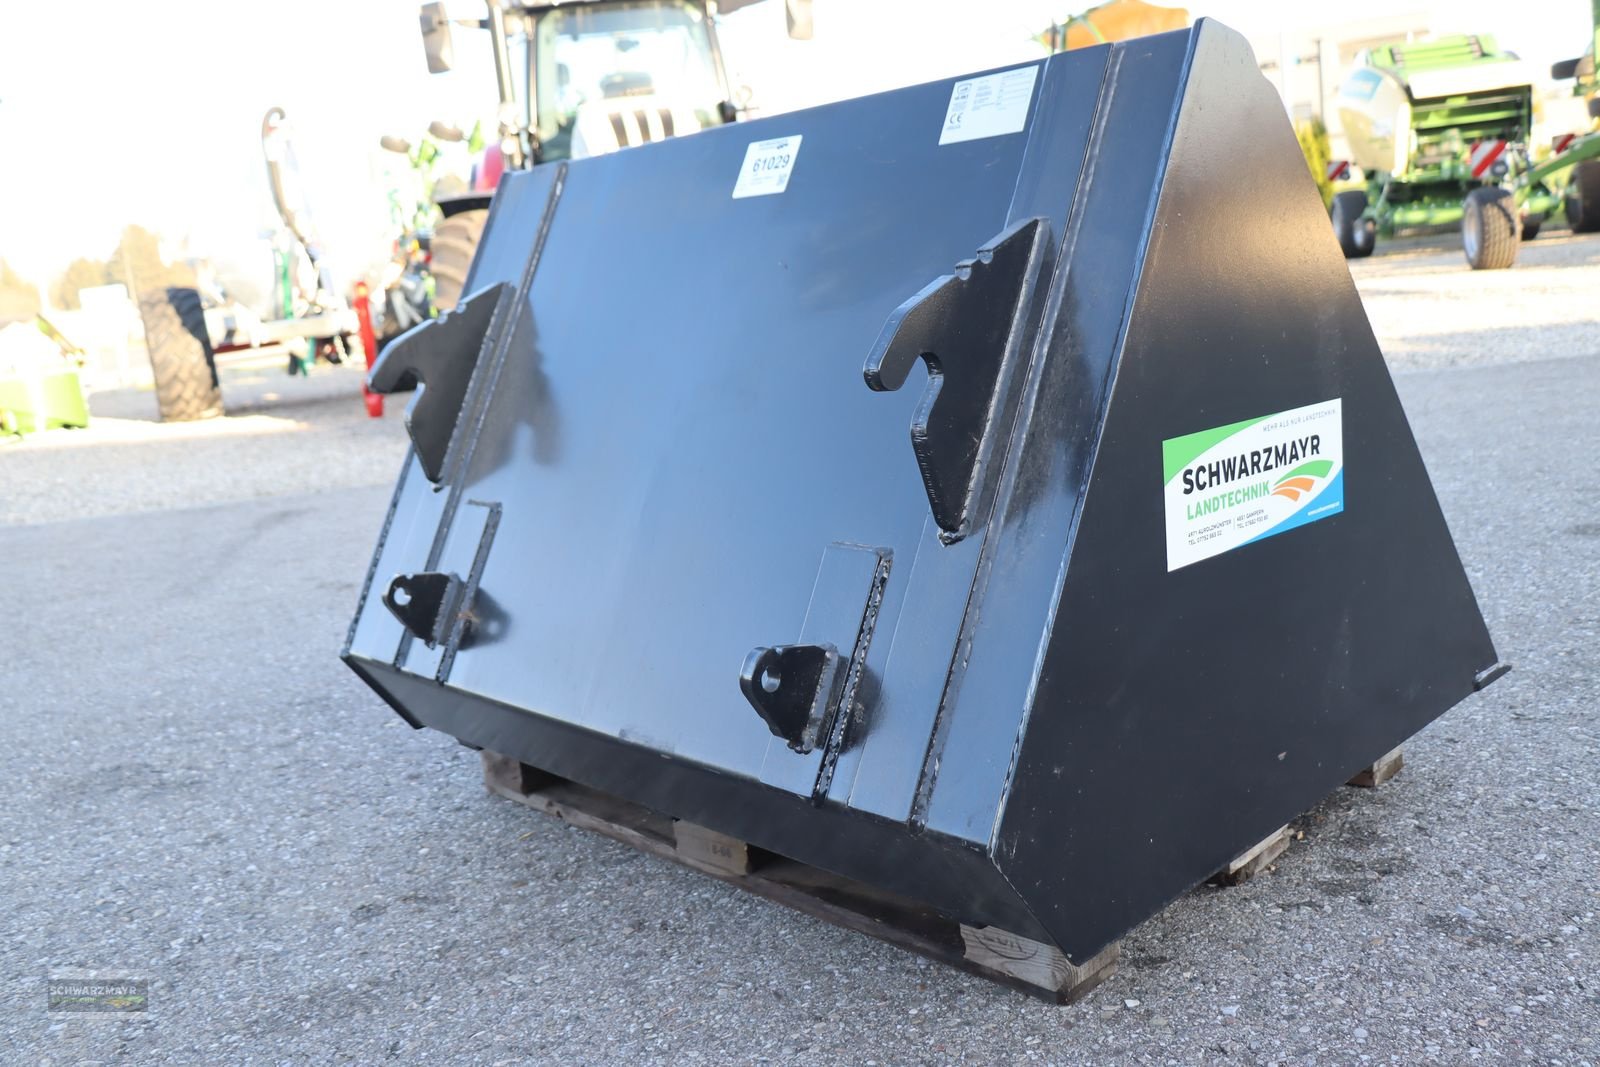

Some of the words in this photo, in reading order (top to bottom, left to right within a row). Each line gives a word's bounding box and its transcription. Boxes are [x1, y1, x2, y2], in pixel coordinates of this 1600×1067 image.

[752, 154, 791, 173] 61029
[1182, 434, 1321, 495] SCHWARZMAYR
[1187, 480, 1270, 521] LANDTECHNIK
